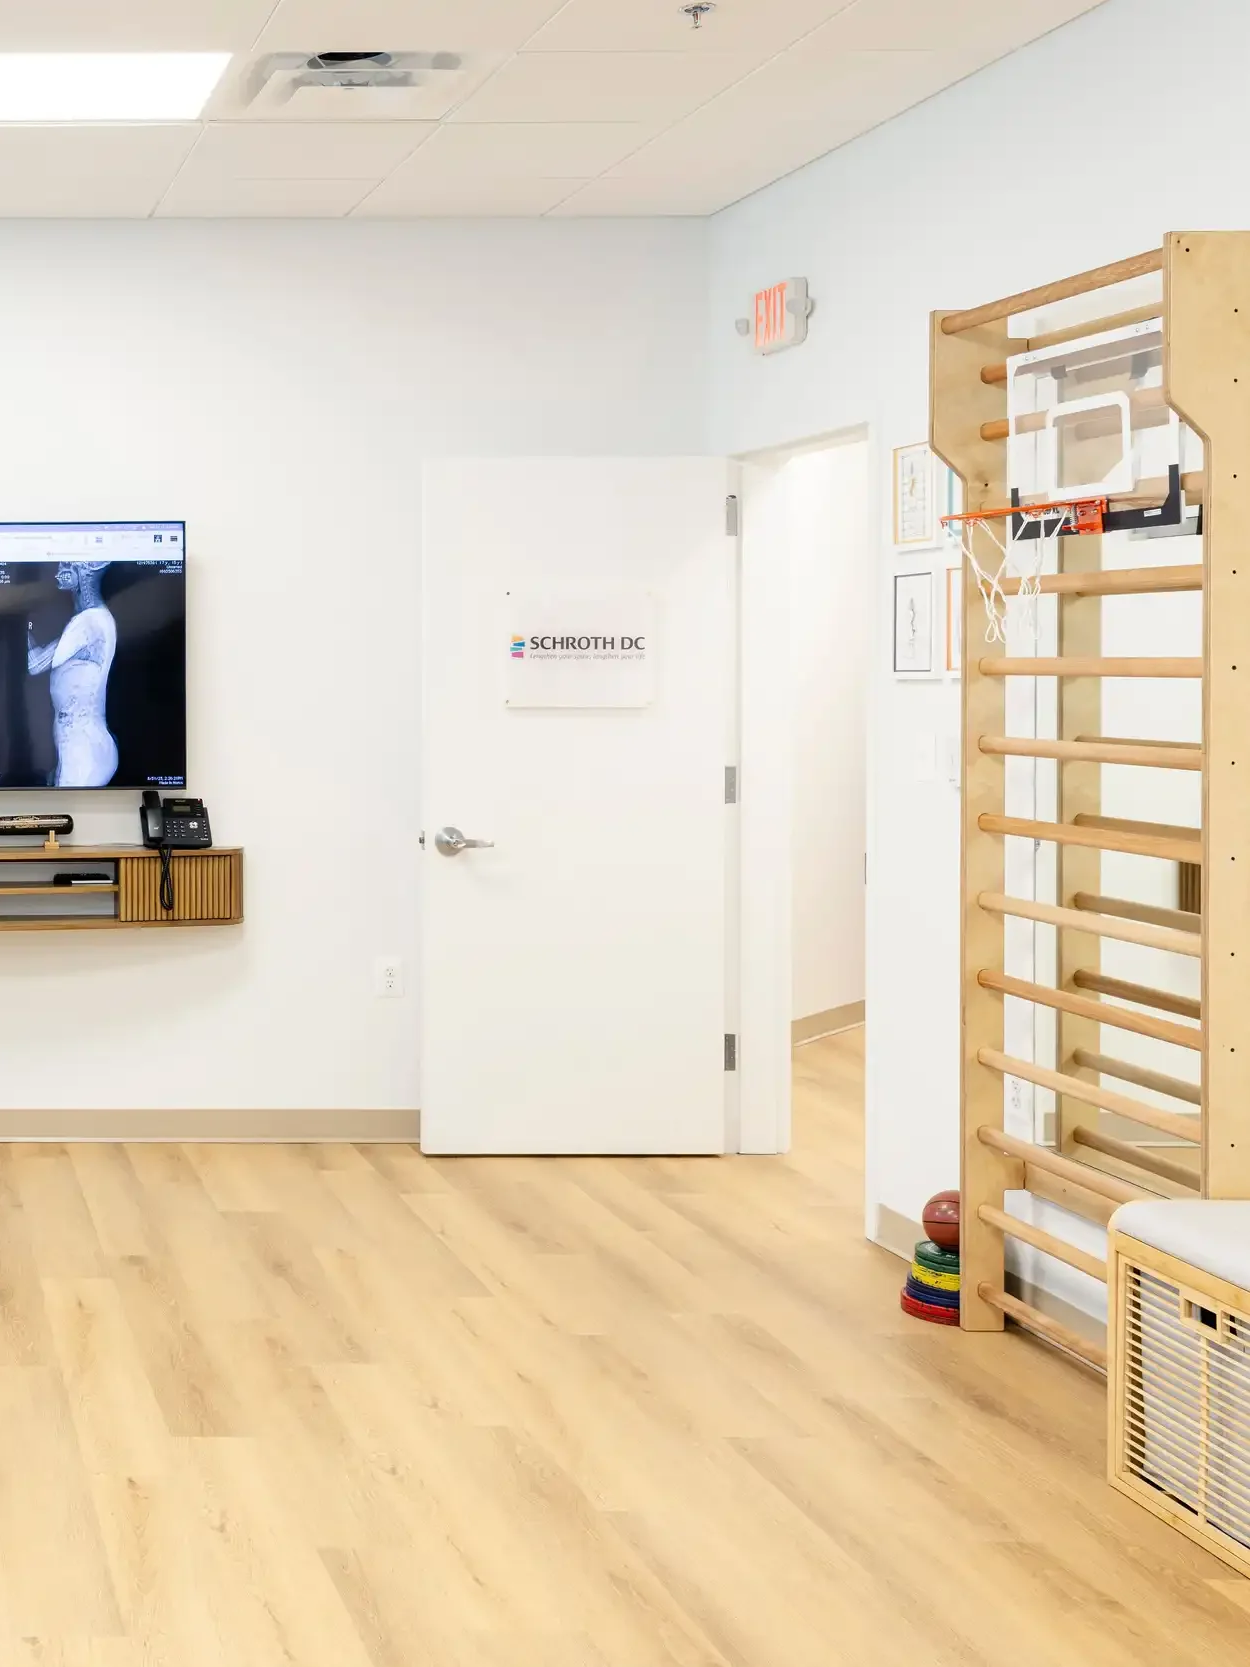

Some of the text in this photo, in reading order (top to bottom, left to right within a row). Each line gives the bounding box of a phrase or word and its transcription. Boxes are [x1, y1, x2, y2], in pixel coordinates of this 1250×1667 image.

[753, 281, 788, 348] EXIT
[530, 636, 646, 650] SCHROTH DC
